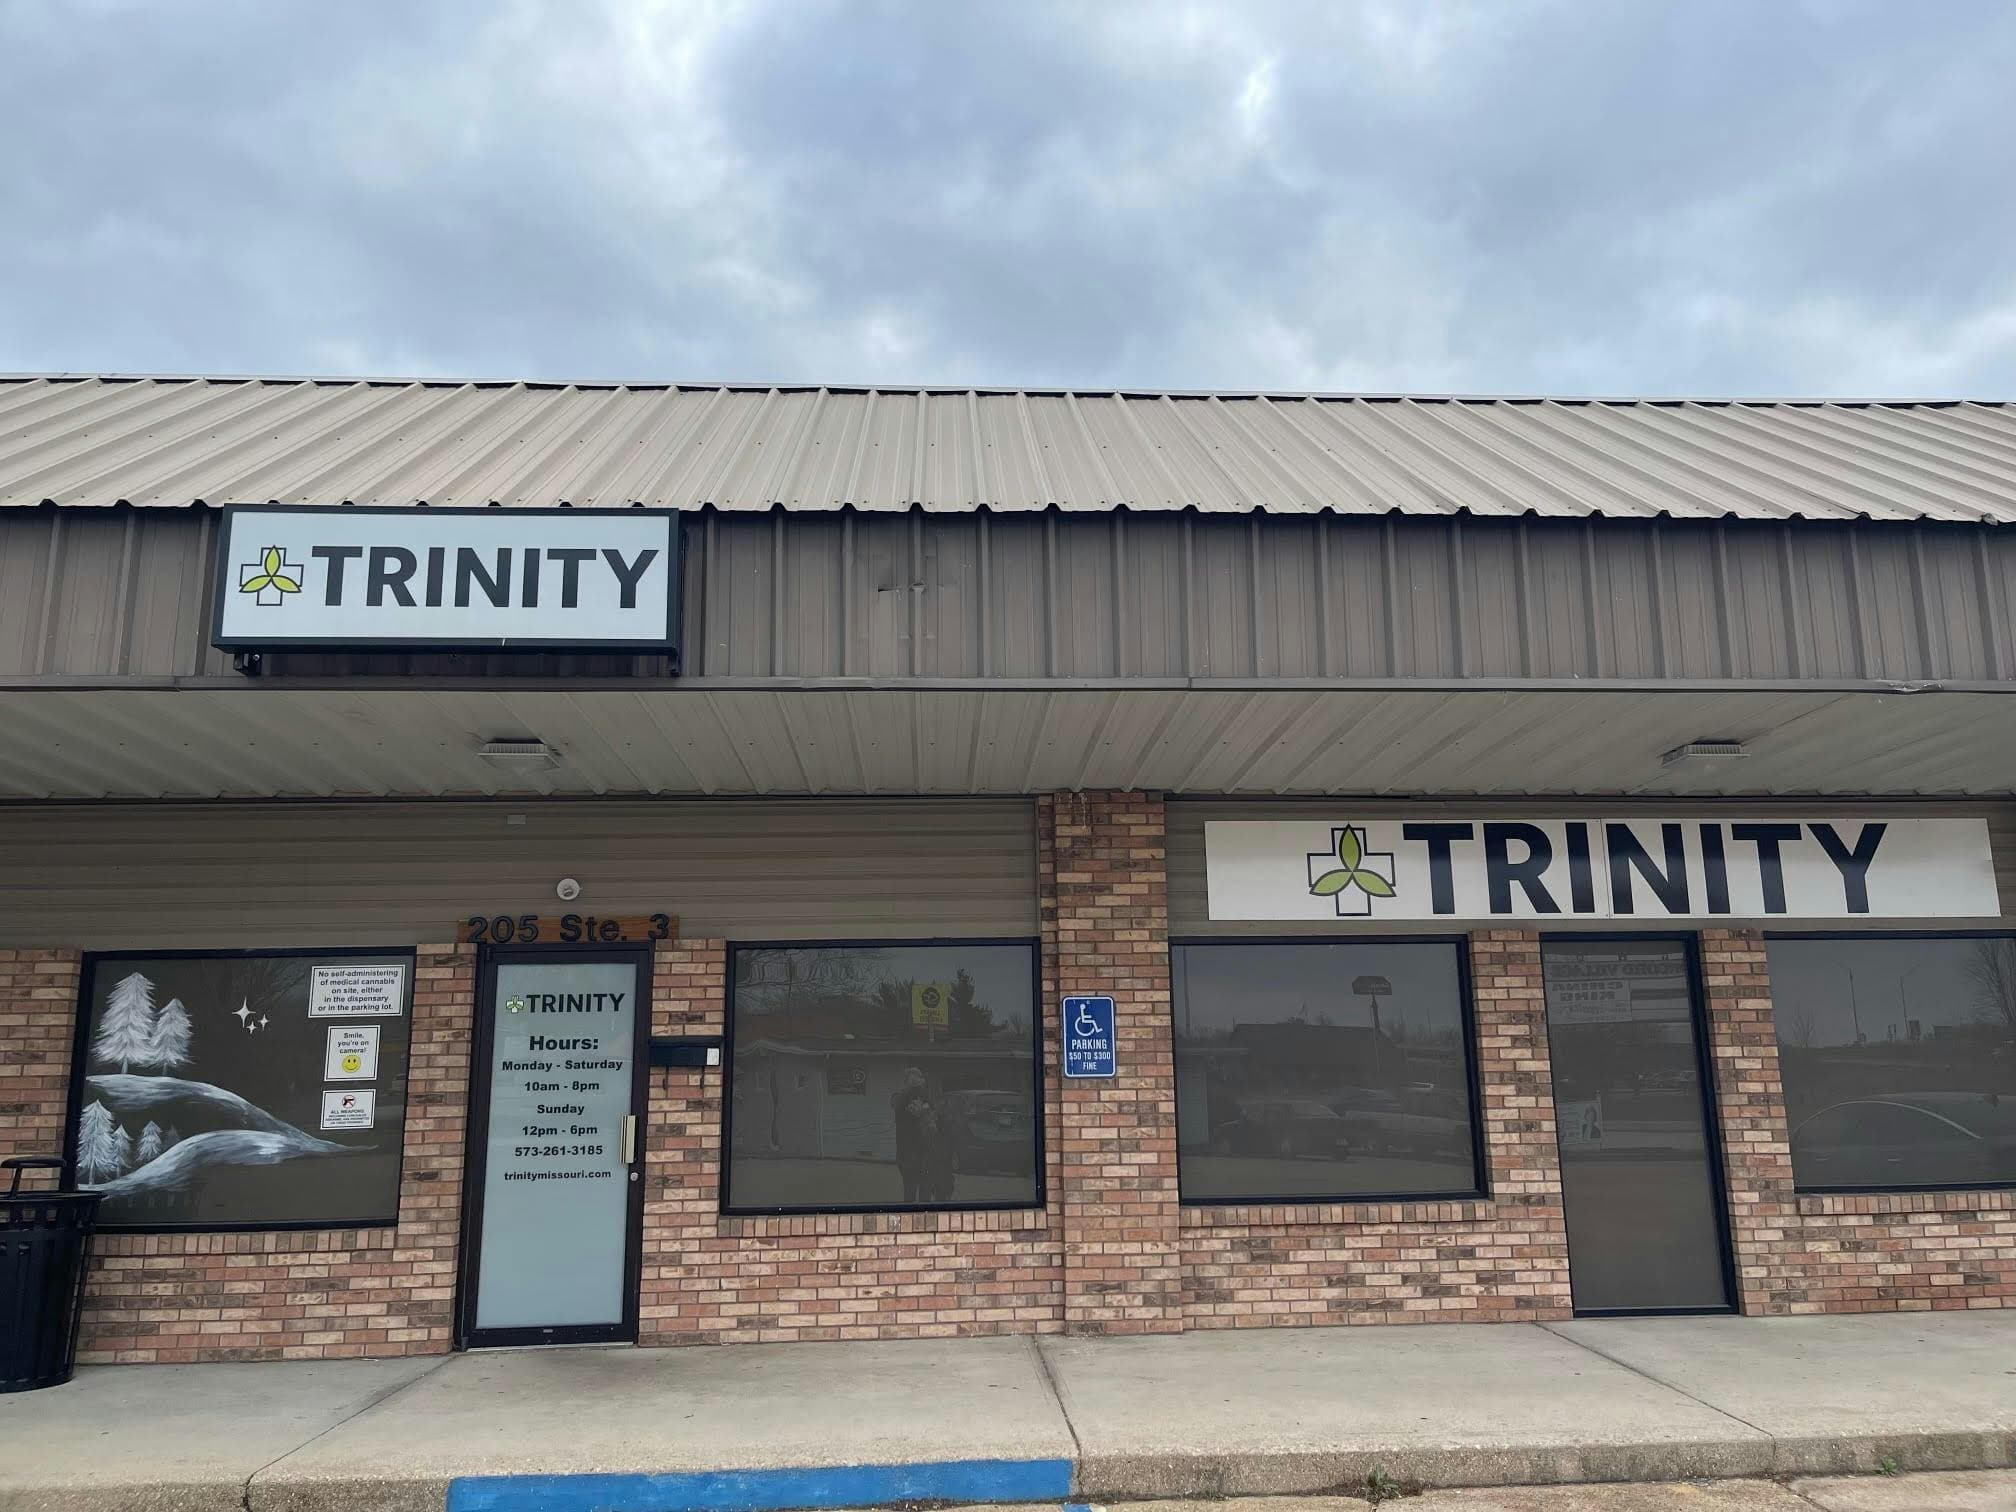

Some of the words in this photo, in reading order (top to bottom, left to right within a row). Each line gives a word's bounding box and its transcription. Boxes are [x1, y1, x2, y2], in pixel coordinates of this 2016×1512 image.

[311, 545, 659, 609] TRINITY
[1402, 822, 1888, 915] TRINITY
[467, 915, 539, 944] 205
[559, 914, 628, 942] Ste.
[648, 913, 670, 942] 3
[347, 995, 389, 1003] dispensary
[526, 993, 625, 1013] TRINITY
[351, 1003, 379, 1011] parking
[529, 1035, 599, 1050] Hours:
[1071, 1039, 1107, 1050] PARKING
[1068, 1052, 1081, 1060] $50
[1084, 1052, 1091, 1060] TO
[1093, 1051, 1111, 1060] $300
[502, 1061, 553, 1072] Monday
[564, 1060, 623, 1071] Saturday
[1082, 1061, 1097, 1070] FINE
[525, 1081, 560, 1091] 10am
[572, 1081, 600, 1092] 8pm
[537, 1104, 585, 1115] Sunday
[522, 1126, 558, 1137] 12pm
[570, 1125, 598, 1136] 6pm
[514, 1145, 603, 1157] 573-261-3185
[504, 1170, 611, 1181] trinitymissouri.com
